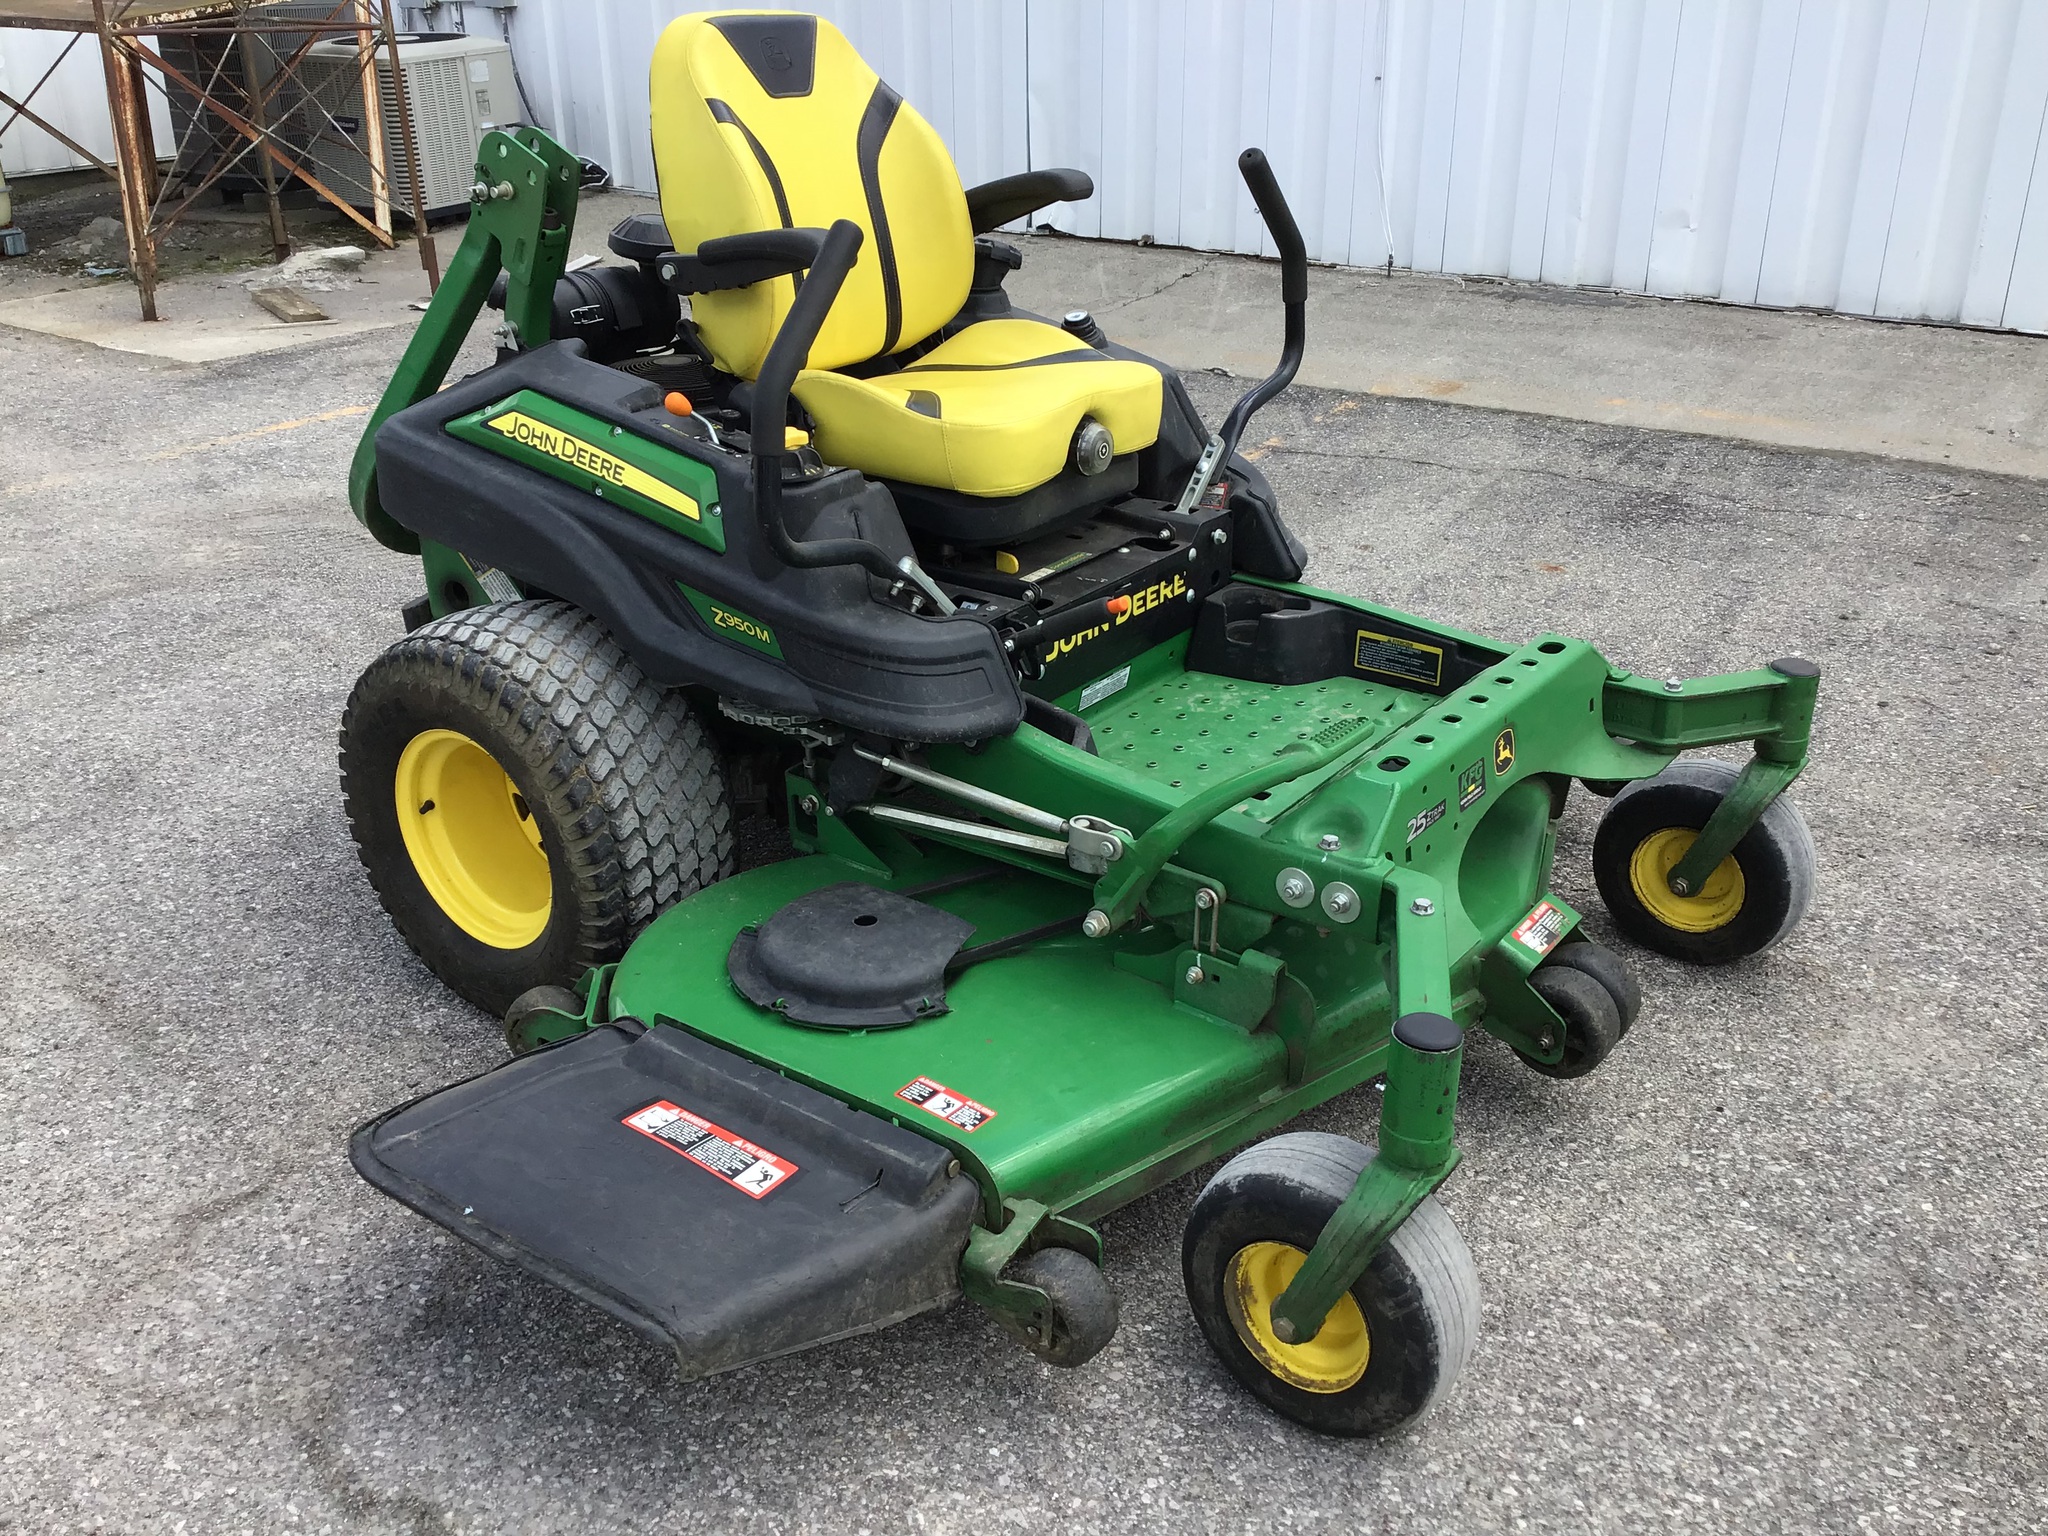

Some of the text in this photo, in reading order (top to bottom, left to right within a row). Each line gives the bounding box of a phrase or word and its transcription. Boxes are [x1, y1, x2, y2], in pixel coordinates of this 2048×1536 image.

[506, 416, 626, 484] JOHN DEERE
[1115, 573, 1187, 626] DEERE
[1406, 809, 1427, 844] 25
[679, 1110, 713, 1130] DANGER
[741, 1141, 778, 1164] PELIGRO
